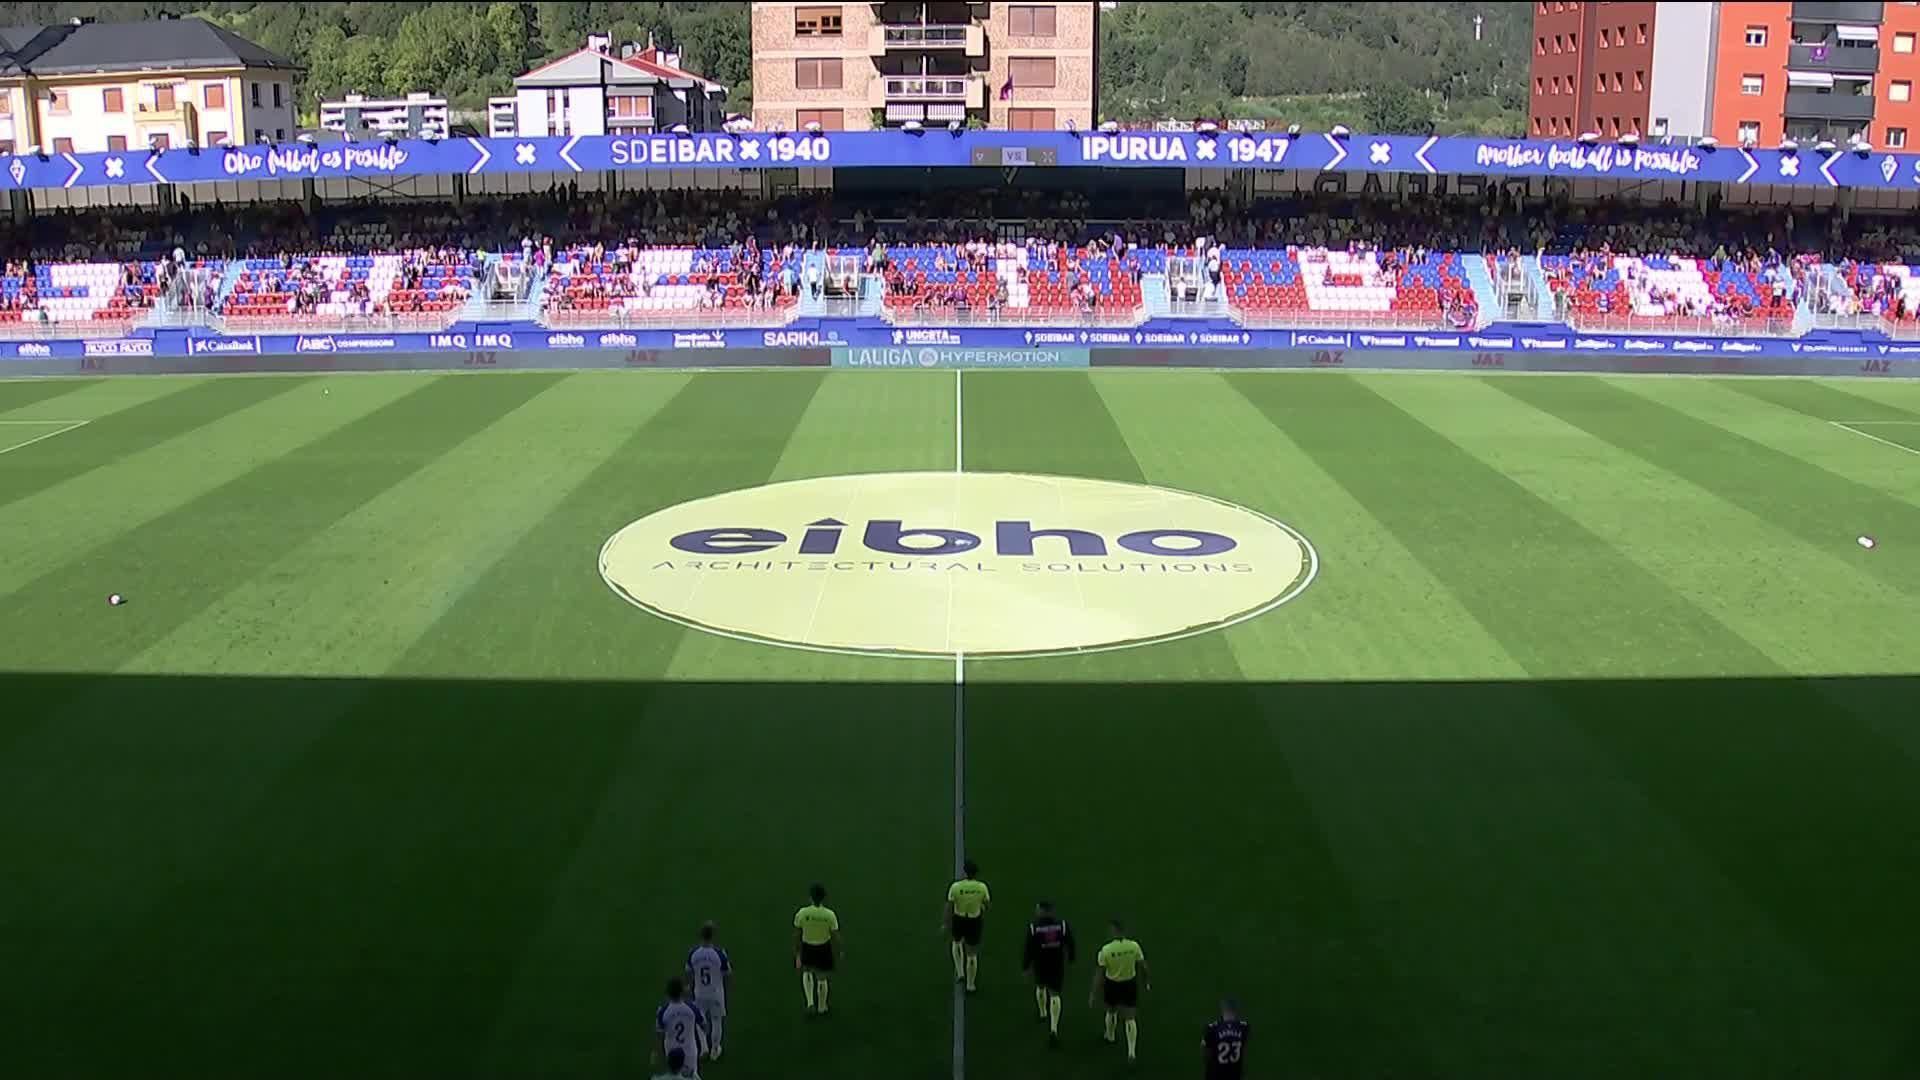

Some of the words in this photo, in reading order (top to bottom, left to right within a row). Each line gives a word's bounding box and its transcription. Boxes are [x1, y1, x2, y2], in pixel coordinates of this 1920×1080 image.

[766, 137, 830, 161] 1940
[1083, 136, 1188, 161] IPURUA
[1228, 138, 1289, 163] 1947
[1548, 144, 1613, 172] football
[322, 153, 342, 168] es
[430, 335, 467, 349] IMQ
[475, 334, 513, 348] IMQ
[764, 331, 819, 346] SARIKI
[849, 349, 913, 366] LALIGA
[940, 350, 1060, 363] HYPERMOTION
[652, 560, 997, 573] ARCHITECTURAL
[1022, 560, 1254, 573] SOLUTIONS
[700, 967, 711, 986] 5
[674, 1023, 685, 1044] 2
[1216, 1040, 1243, 1065] 23
